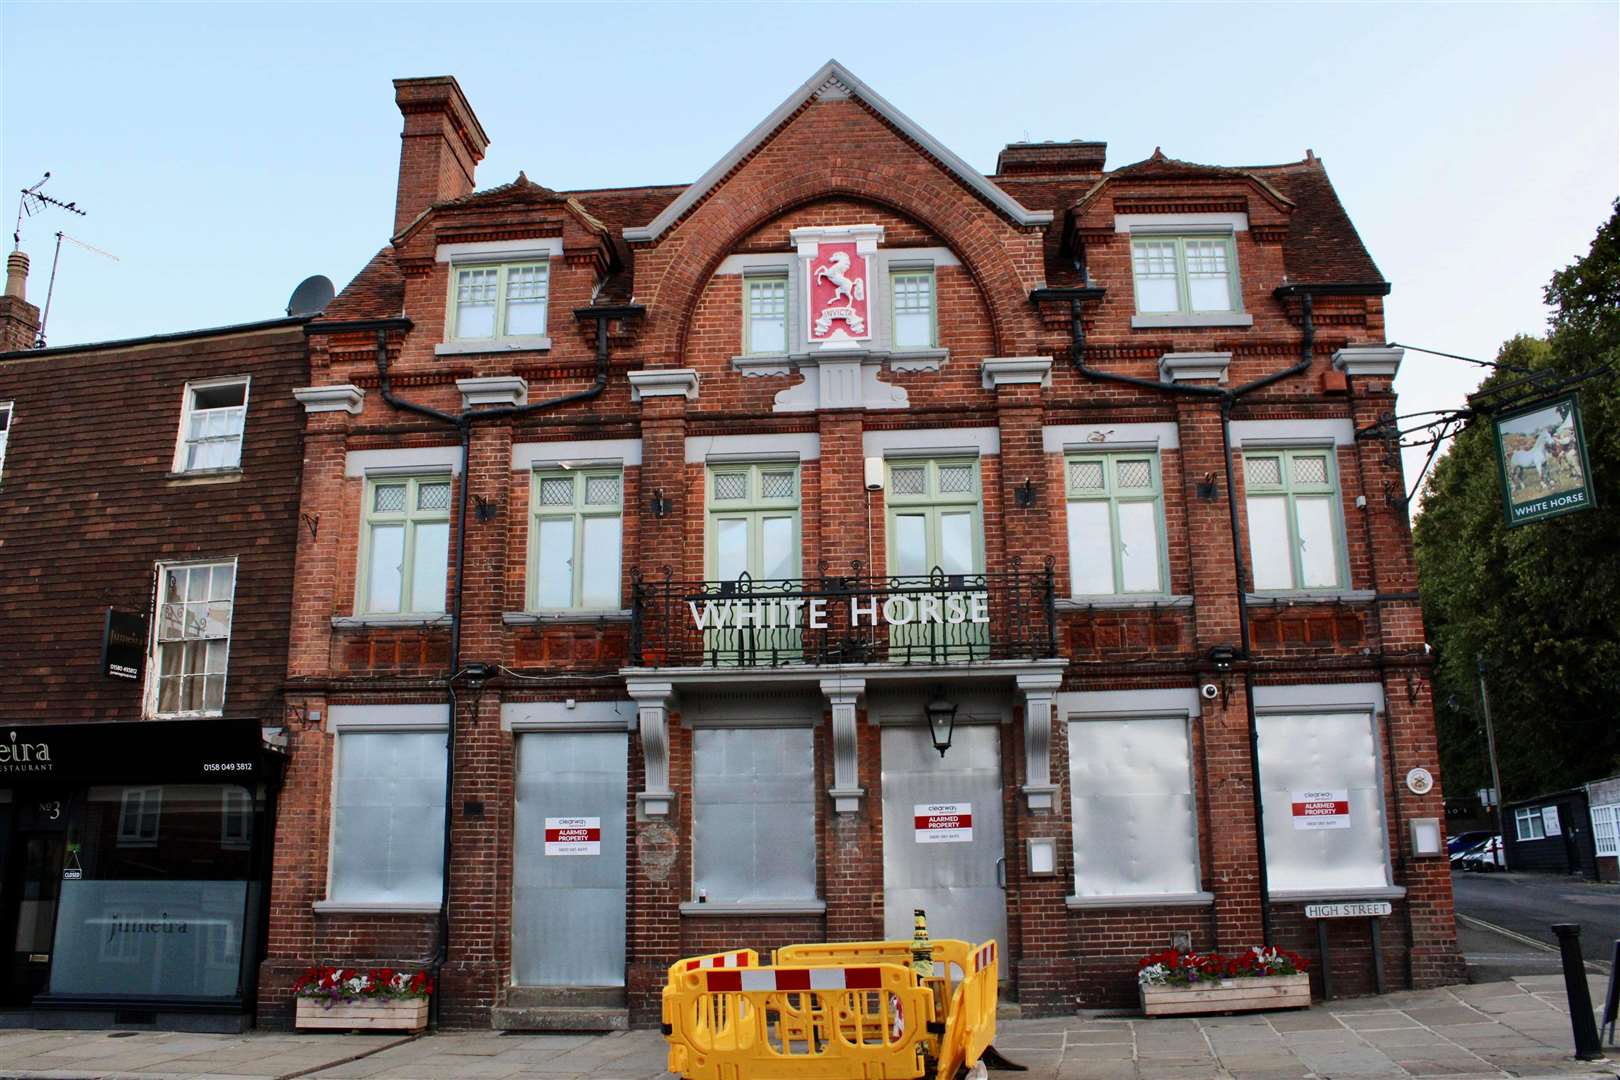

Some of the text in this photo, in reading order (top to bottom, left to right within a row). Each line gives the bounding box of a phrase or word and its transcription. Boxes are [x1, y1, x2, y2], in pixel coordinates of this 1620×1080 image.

[1514, 492, 1584, 517] WHITE HORSE
[688, 593, 990, 630] WHITE HORSE
[203, 762, 253, 771] 0158 049 3812
[1309, 903, 1388, 916] HIGH STREET
